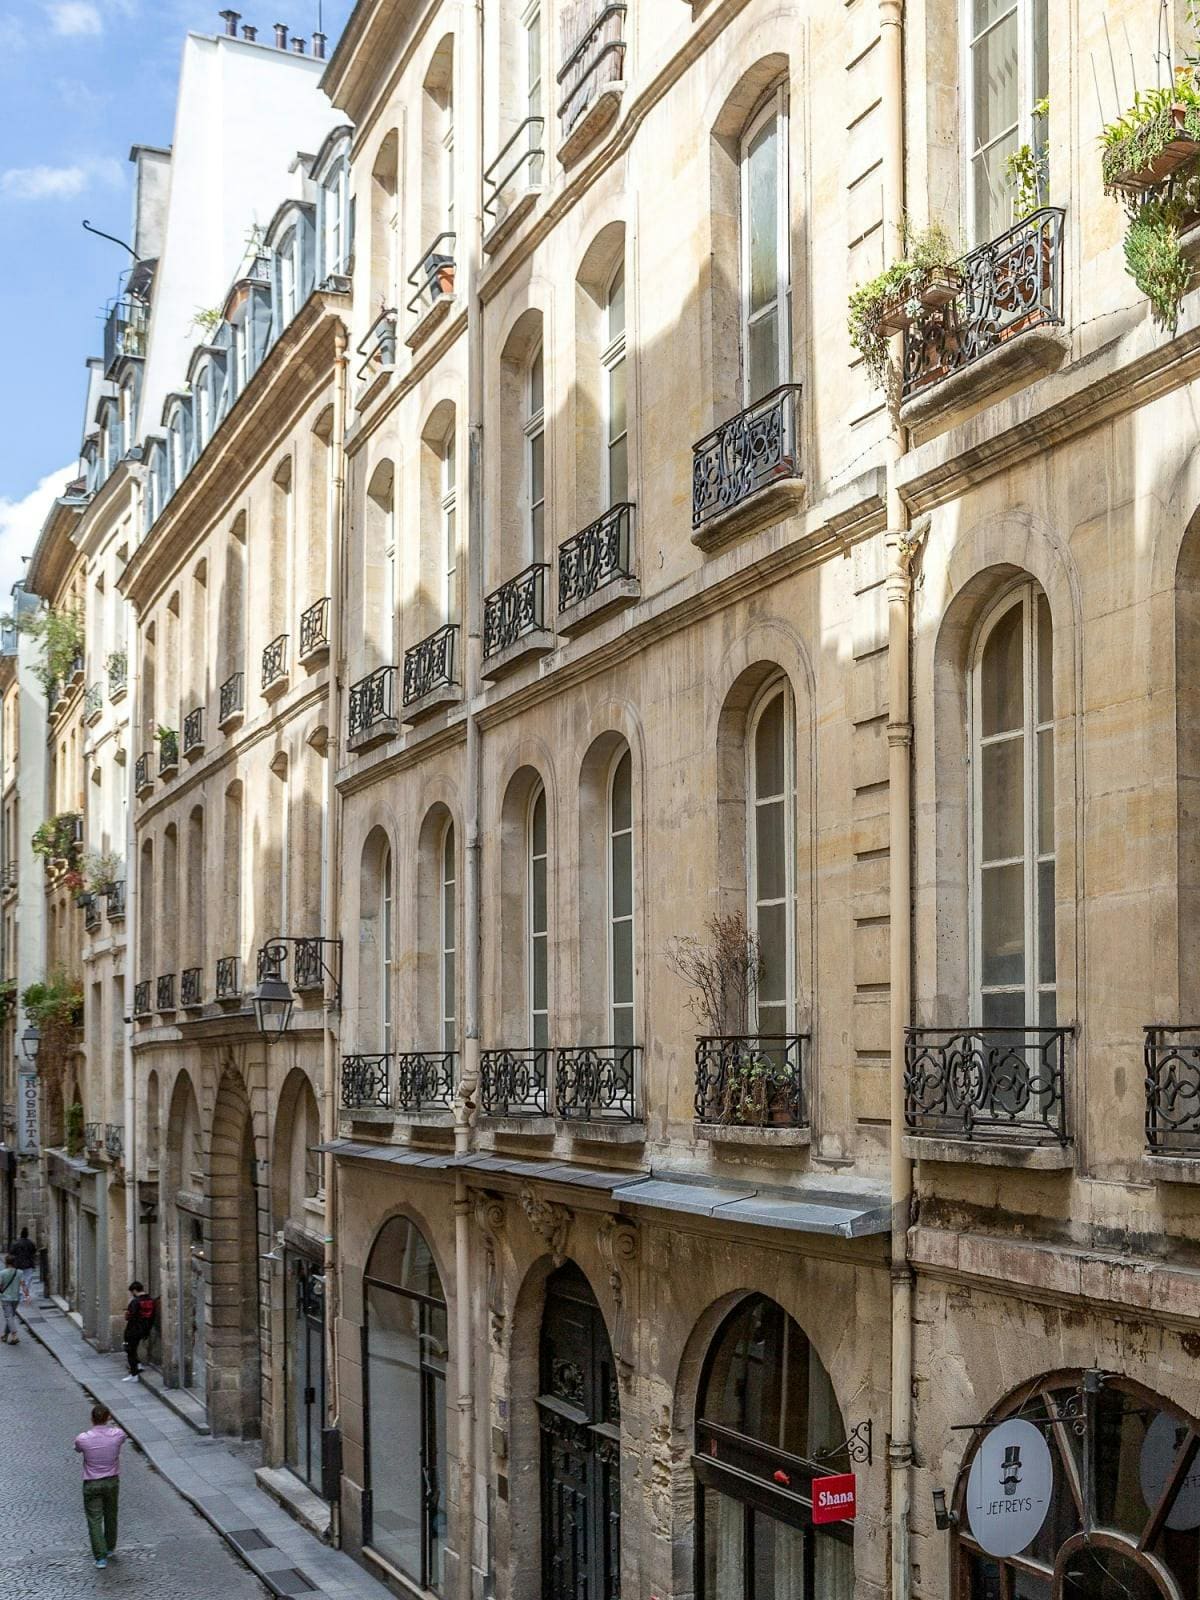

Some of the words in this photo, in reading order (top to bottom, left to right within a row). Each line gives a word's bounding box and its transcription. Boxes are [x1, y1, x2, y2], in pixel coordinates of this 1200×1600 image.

[25, 1079, 37, 1148] ROSETTA
[818, 1491, 854, 1506] Shana
[986, 1497, 1032, 1516] JEFREY'S
